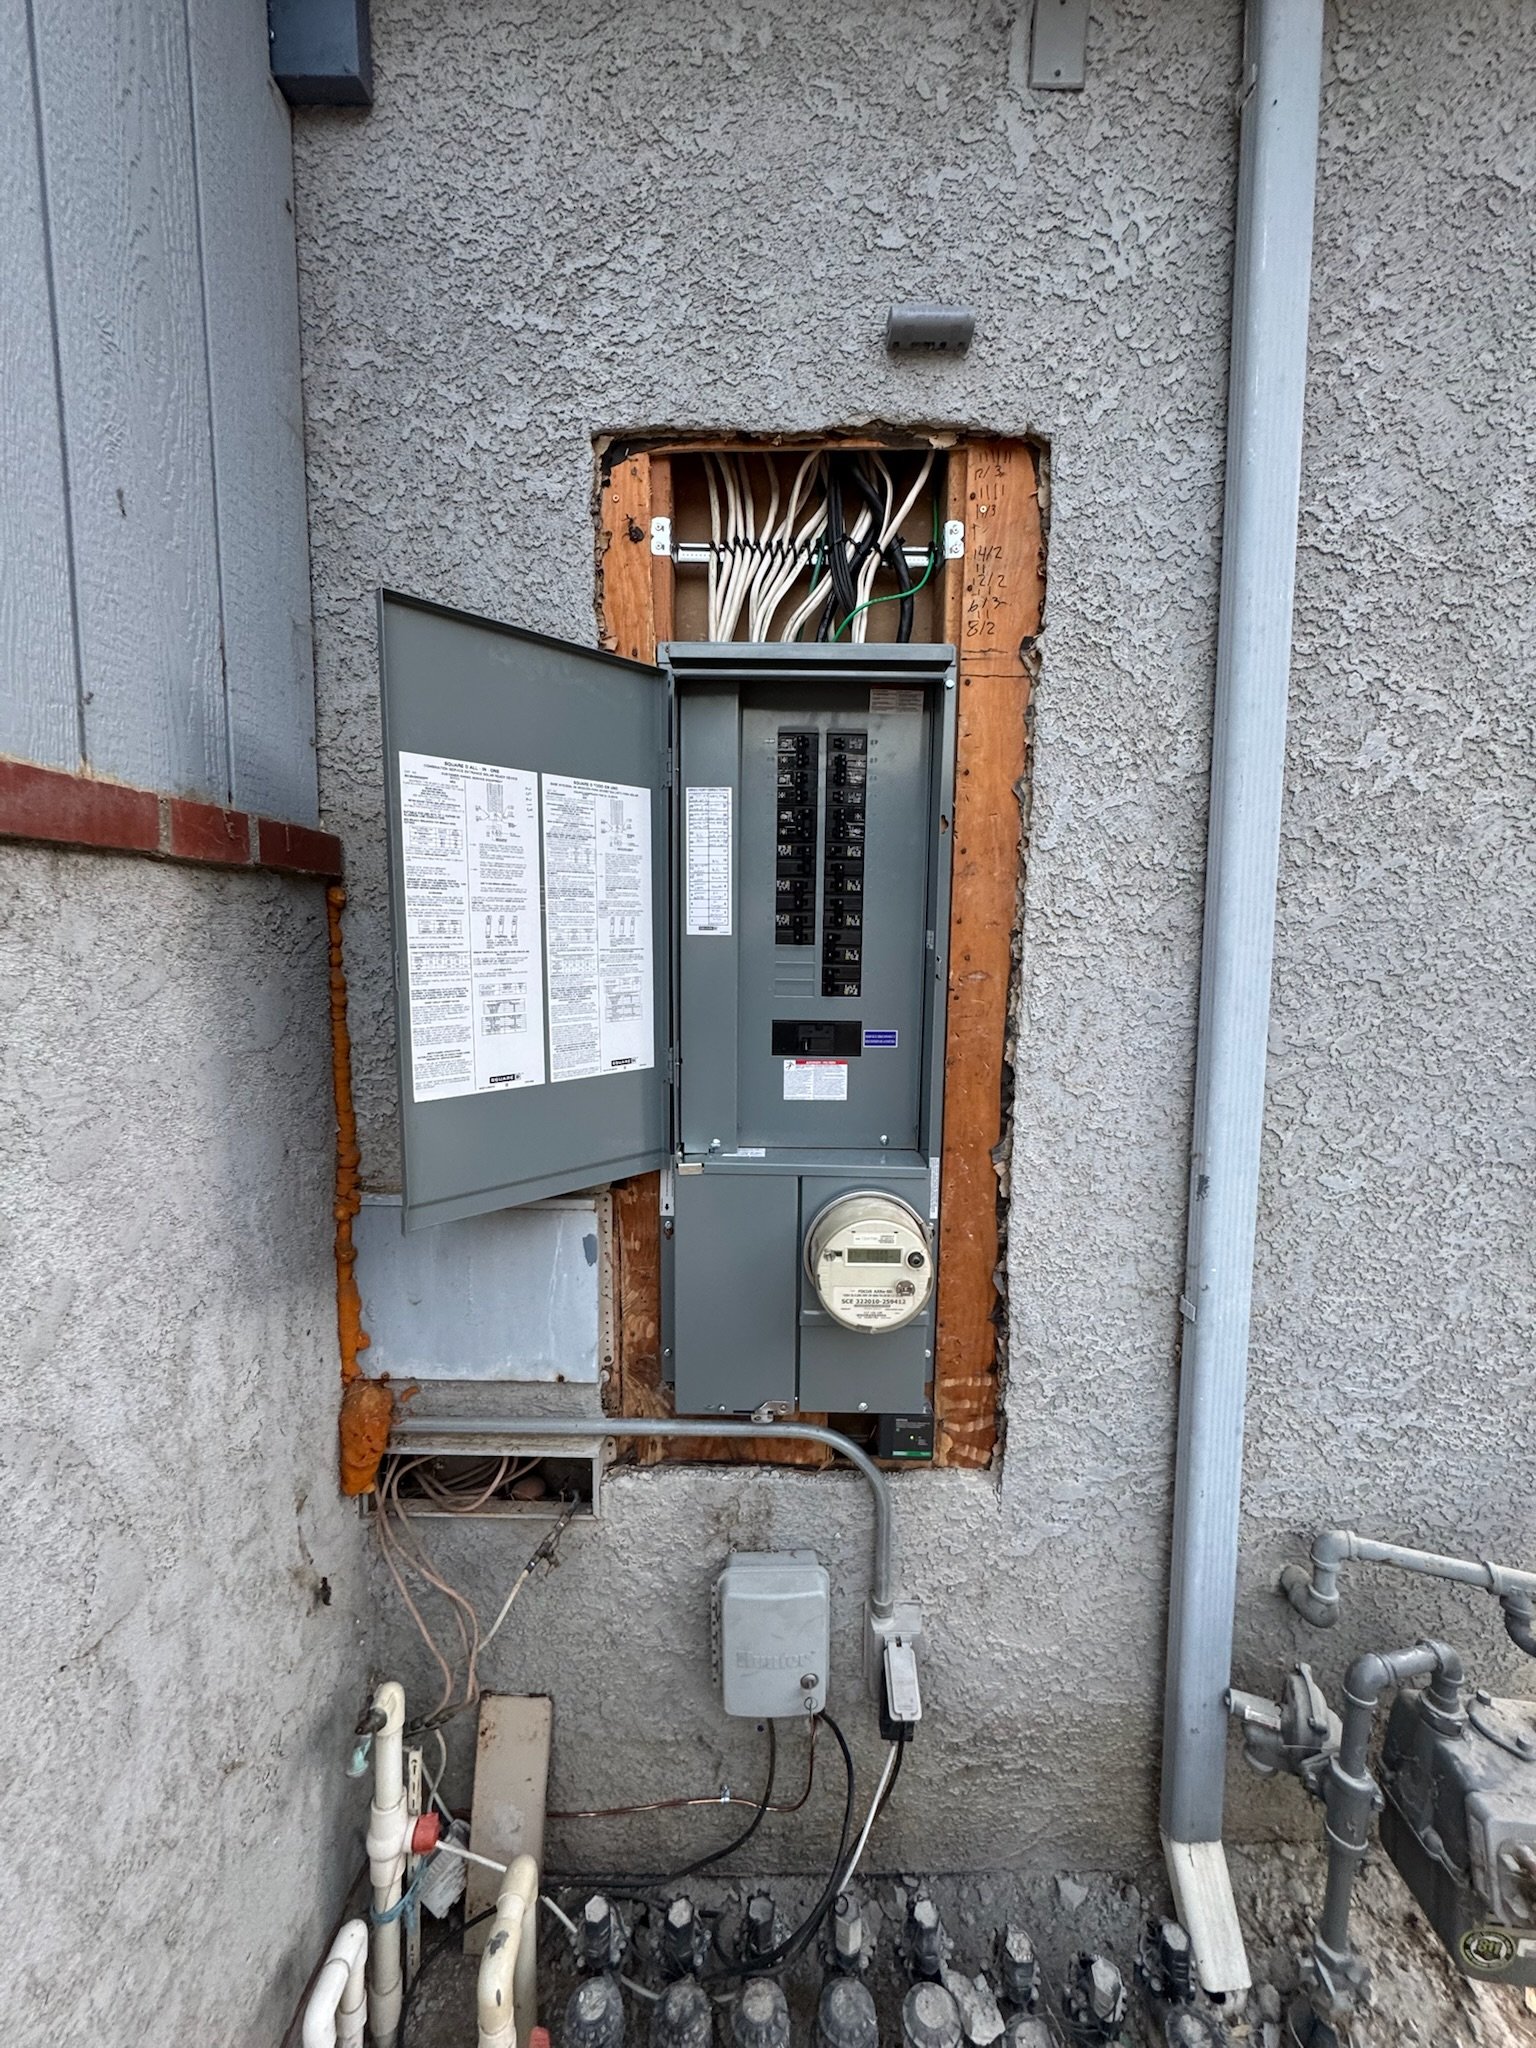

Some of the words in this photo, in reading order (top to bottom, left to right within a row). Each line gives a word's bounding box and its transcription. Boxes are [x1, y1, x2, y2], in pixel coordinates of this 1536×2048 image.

[973, 545, 1003, 562] 14/2
[966, 620, 996, 637] 8/2
[490, 1075, 514, 1083] SQUARE
